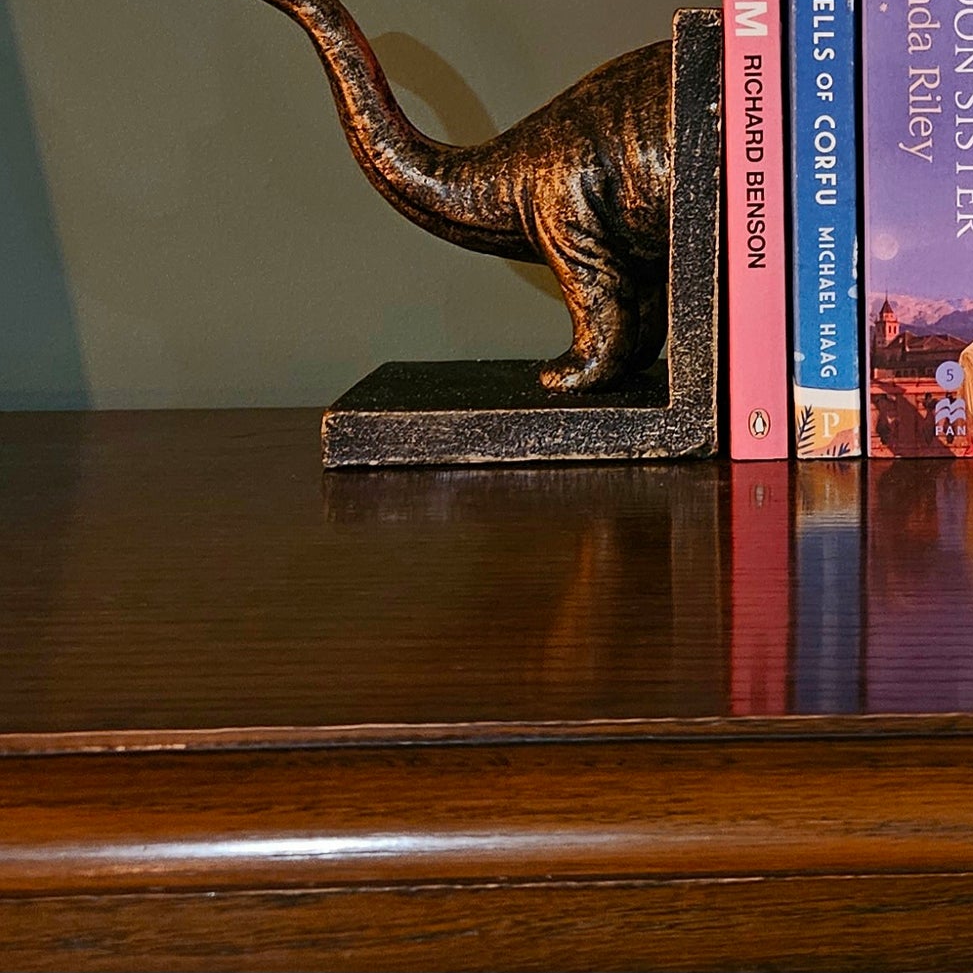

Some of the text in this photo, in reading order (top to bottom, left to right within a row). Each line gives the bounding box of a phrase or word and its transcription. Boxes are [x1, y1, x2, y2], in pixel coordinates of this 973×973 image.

[816, 73, 833, 102] OF
[899, 65, 942, 163] Riley
[744, 54, 767, 269] RICHARD BENSON
[814, 115, 836, 205] CORFU
[818, 227, 837, 378] MICHAEL HAAG
[945, 368, 954, 382] 5
[935, 425, 967, 437] PAN
